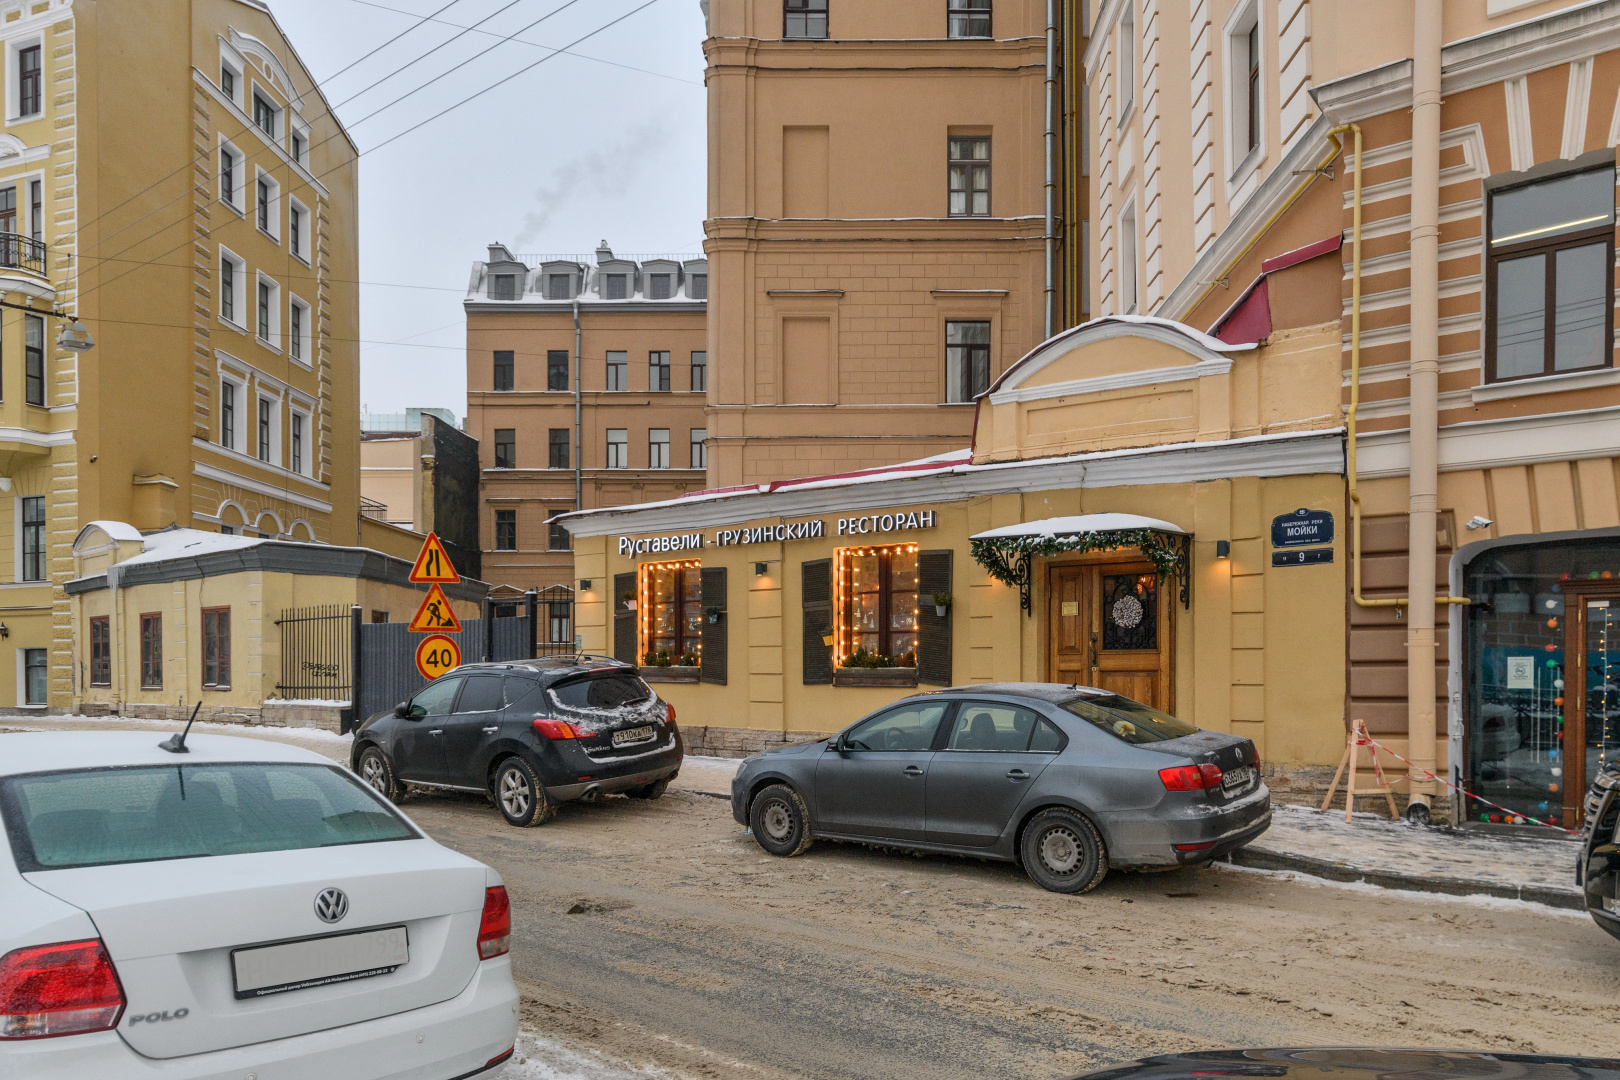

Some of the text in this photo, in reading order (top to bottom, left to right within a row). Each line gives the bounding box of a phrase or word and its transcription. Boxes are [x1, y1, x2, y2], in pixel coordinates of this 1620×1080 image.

[1281, 520, 1309, 528] НАБЕРЕЖНАЯ
[1287, 525, 1317, 536] МОЙКИ
[619, 533, 701, 559] Руставели
[716, 519, 823, 546] ГРУЗИНСКИЙ
[838, 510, 933, 535] РЕСТОРАН
[1298, 552, 1305, 562] 9
[425, 648, 453, 668] 40
[128, 1007, 190, 1027] POLO
